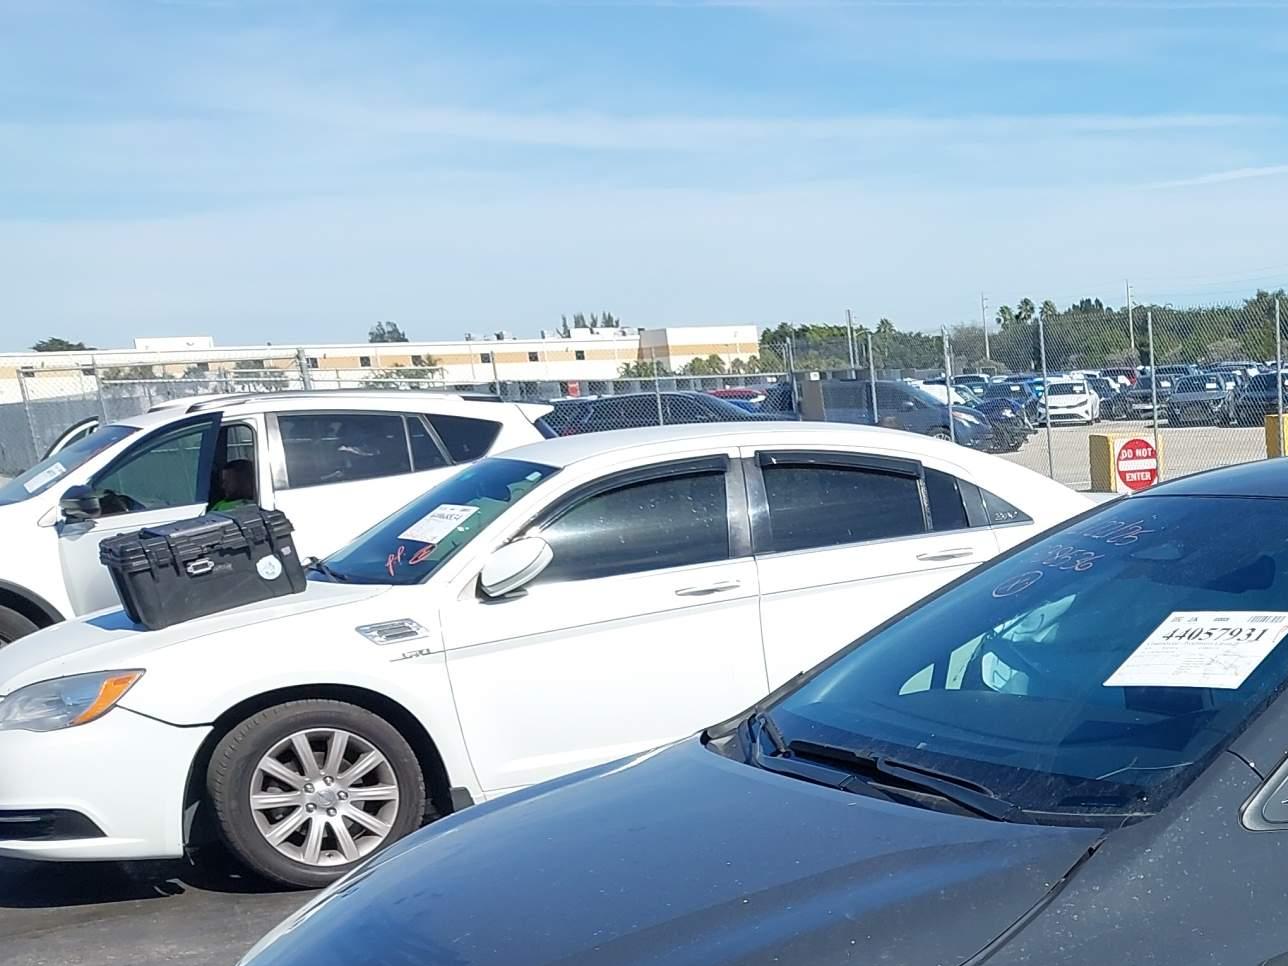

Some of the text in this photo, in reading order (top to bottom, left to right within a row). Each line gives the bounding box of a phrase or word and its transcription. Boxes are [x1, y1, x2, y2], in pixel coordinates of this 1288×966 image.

[1121, 448, 1152, 459] DO NOT
[1125, 472, 1151, 482] ENTER
[1160, 627, 1270, 643] 44057931
